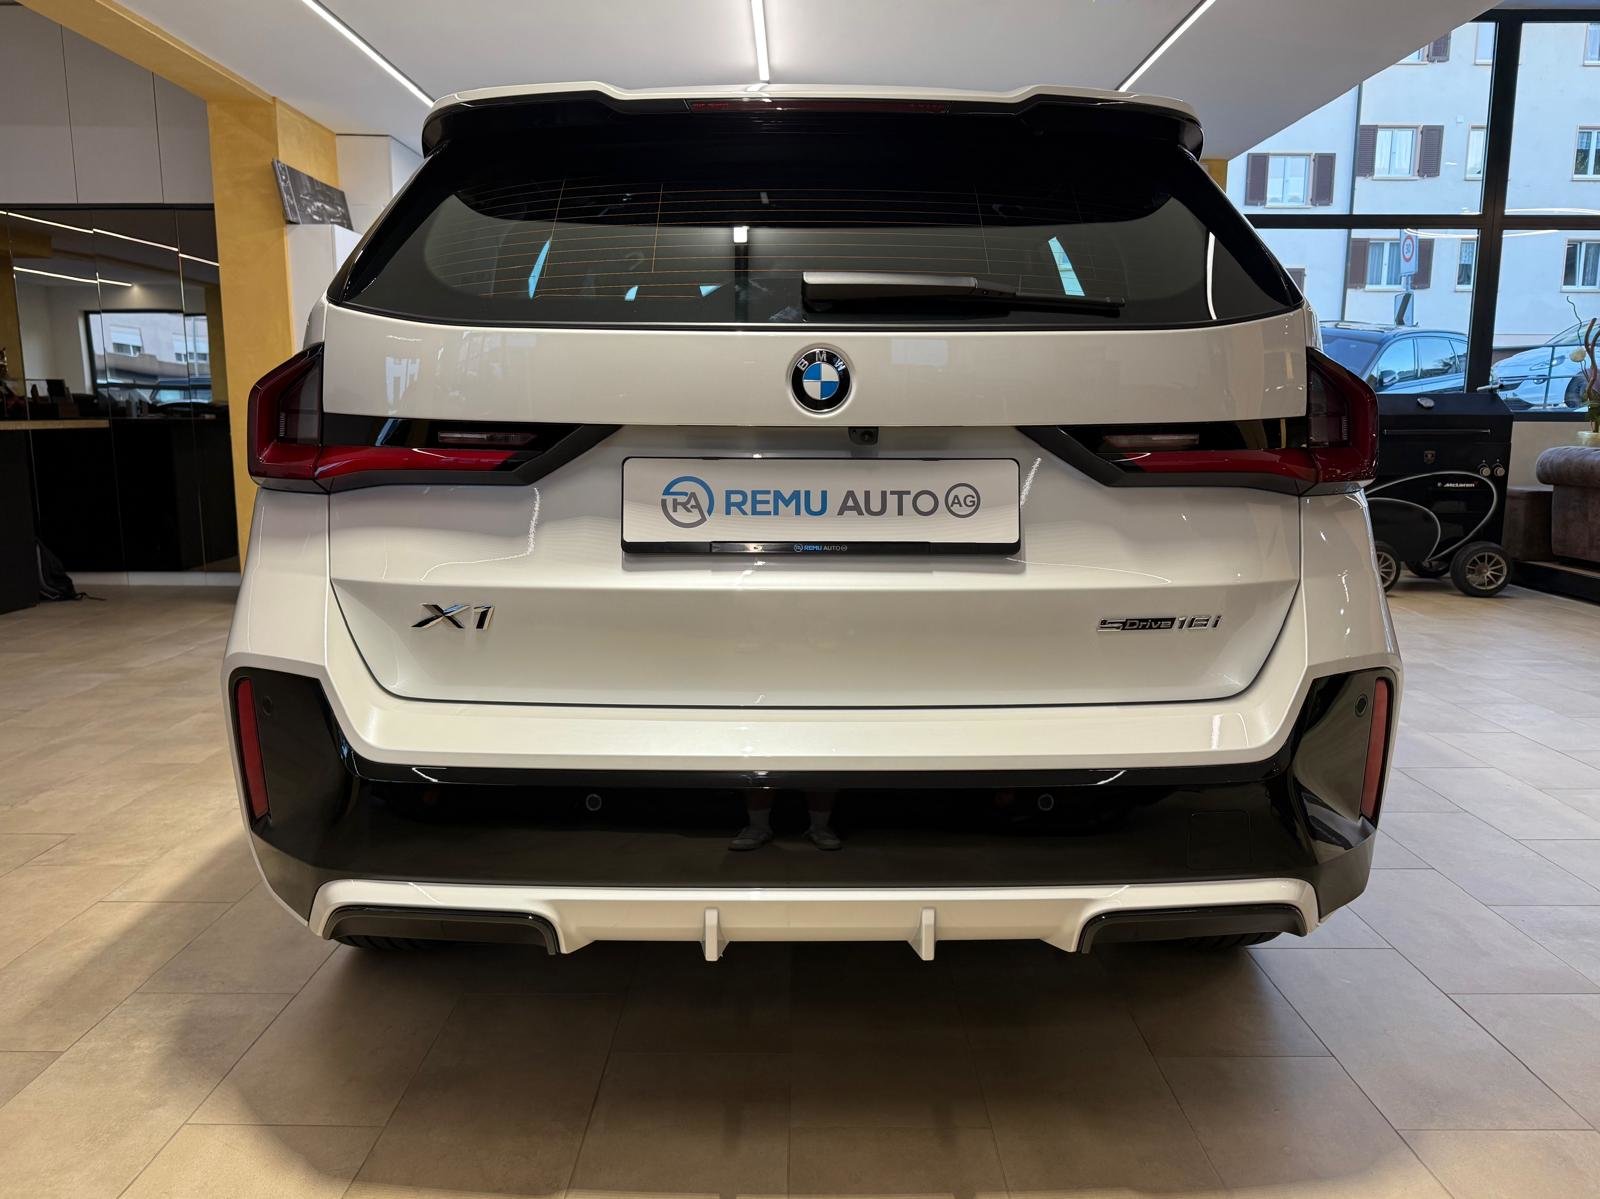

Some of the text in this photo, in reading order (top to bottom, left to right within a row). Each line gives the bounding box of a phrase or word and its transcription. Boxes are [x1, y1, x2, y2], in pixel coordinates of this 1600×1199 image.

[797, 350, 845, 371] BMW
[725, 490, 828, 516] REMU
[837, 490, 939, 517] AUTO
[950, 495, 976, 508] AG
[411, 603, 495, 630] X1
